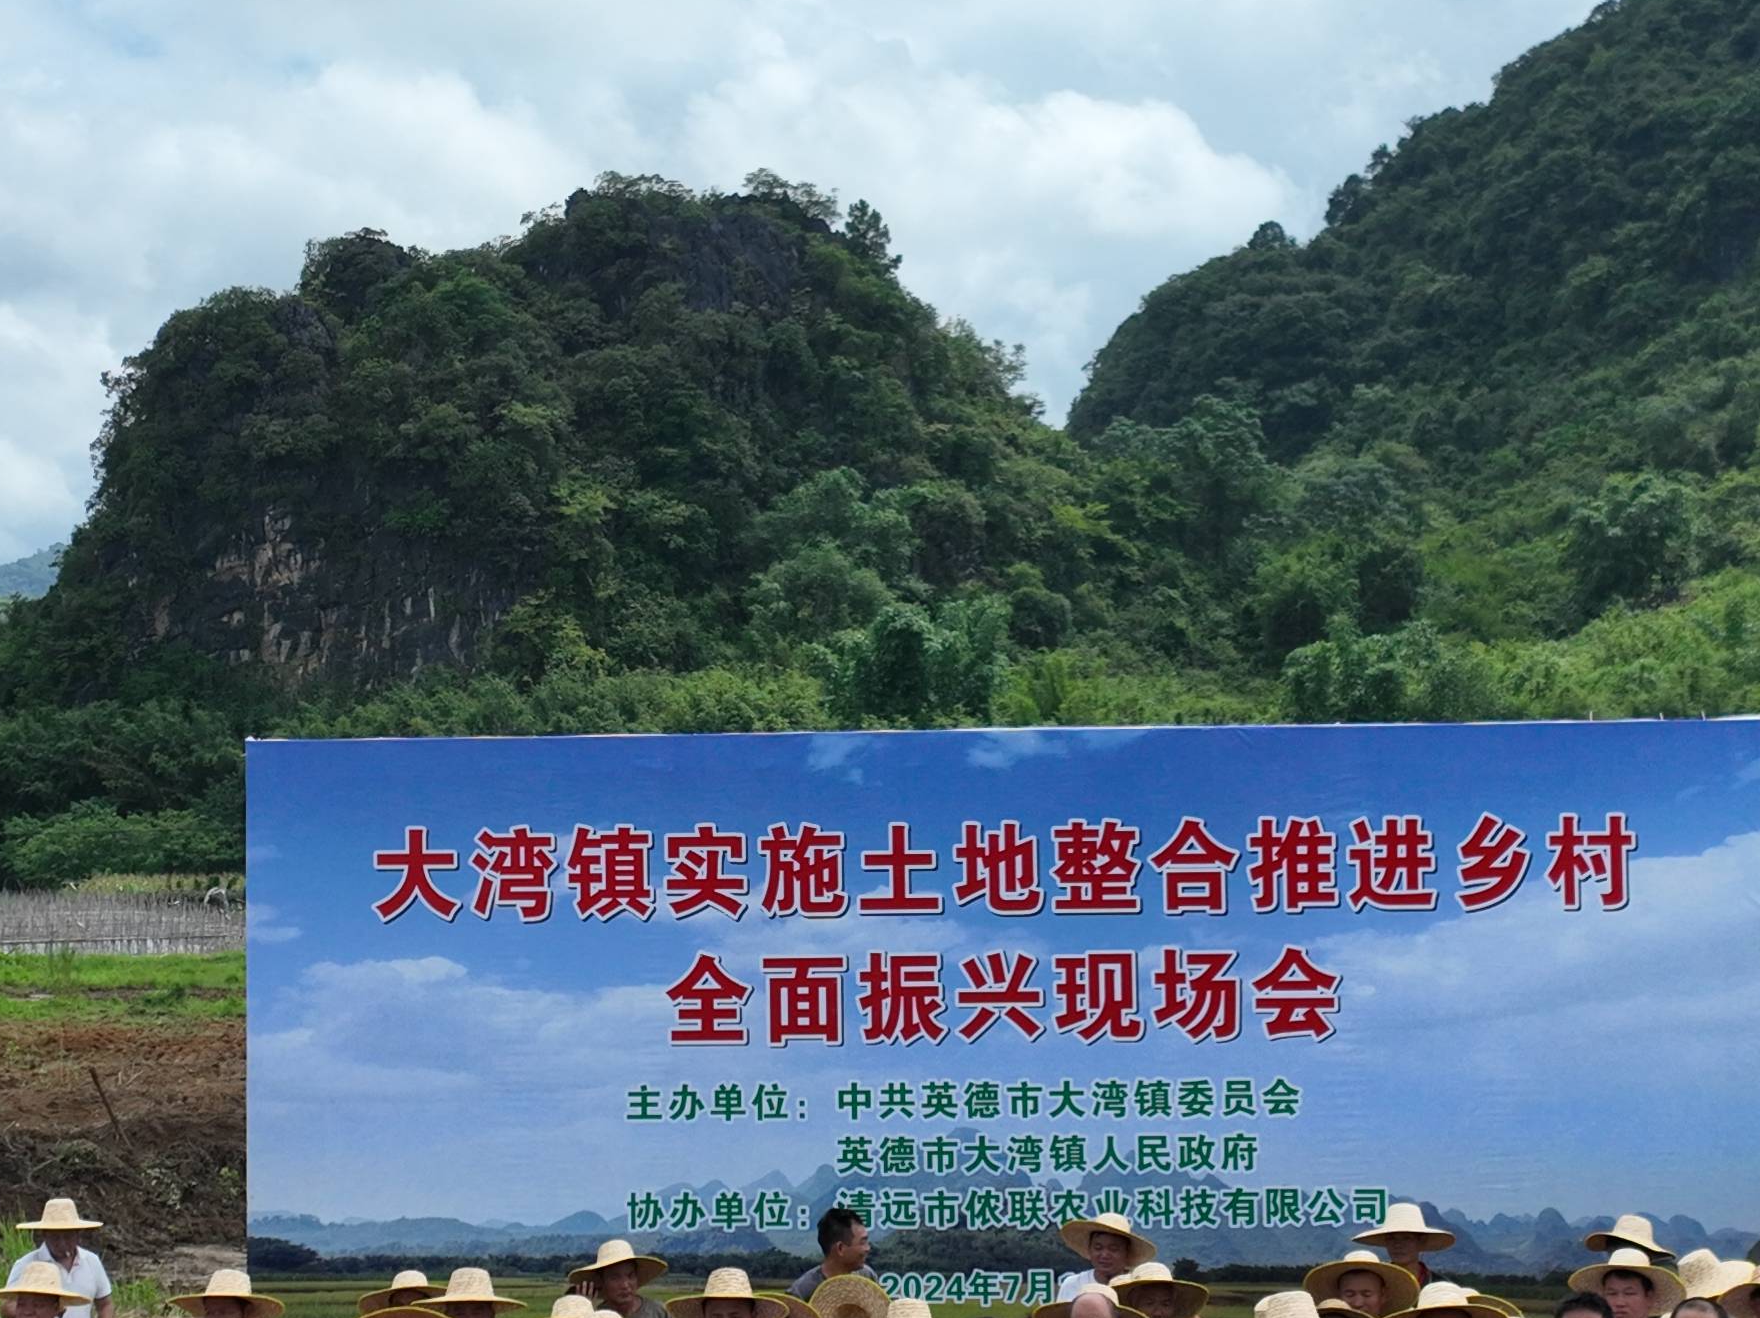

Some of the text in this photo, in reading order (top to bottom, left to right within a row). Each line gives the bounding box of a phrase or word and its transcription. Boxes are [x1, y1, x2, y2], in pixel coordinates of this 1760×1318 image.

[373, 812, 1636, 921] 大湾镇实施土地整合推进乡村
[665, 945, 1340, 1047] 全面振兴现场会
[626, 1078, 1302, 1122] 主办单位：中共英德市大湾镇委员会
[837, 1133, 1259, 1174] 英德市大湾镇人民政府
[878, 1267, 1082, 1306] 2024年7月
